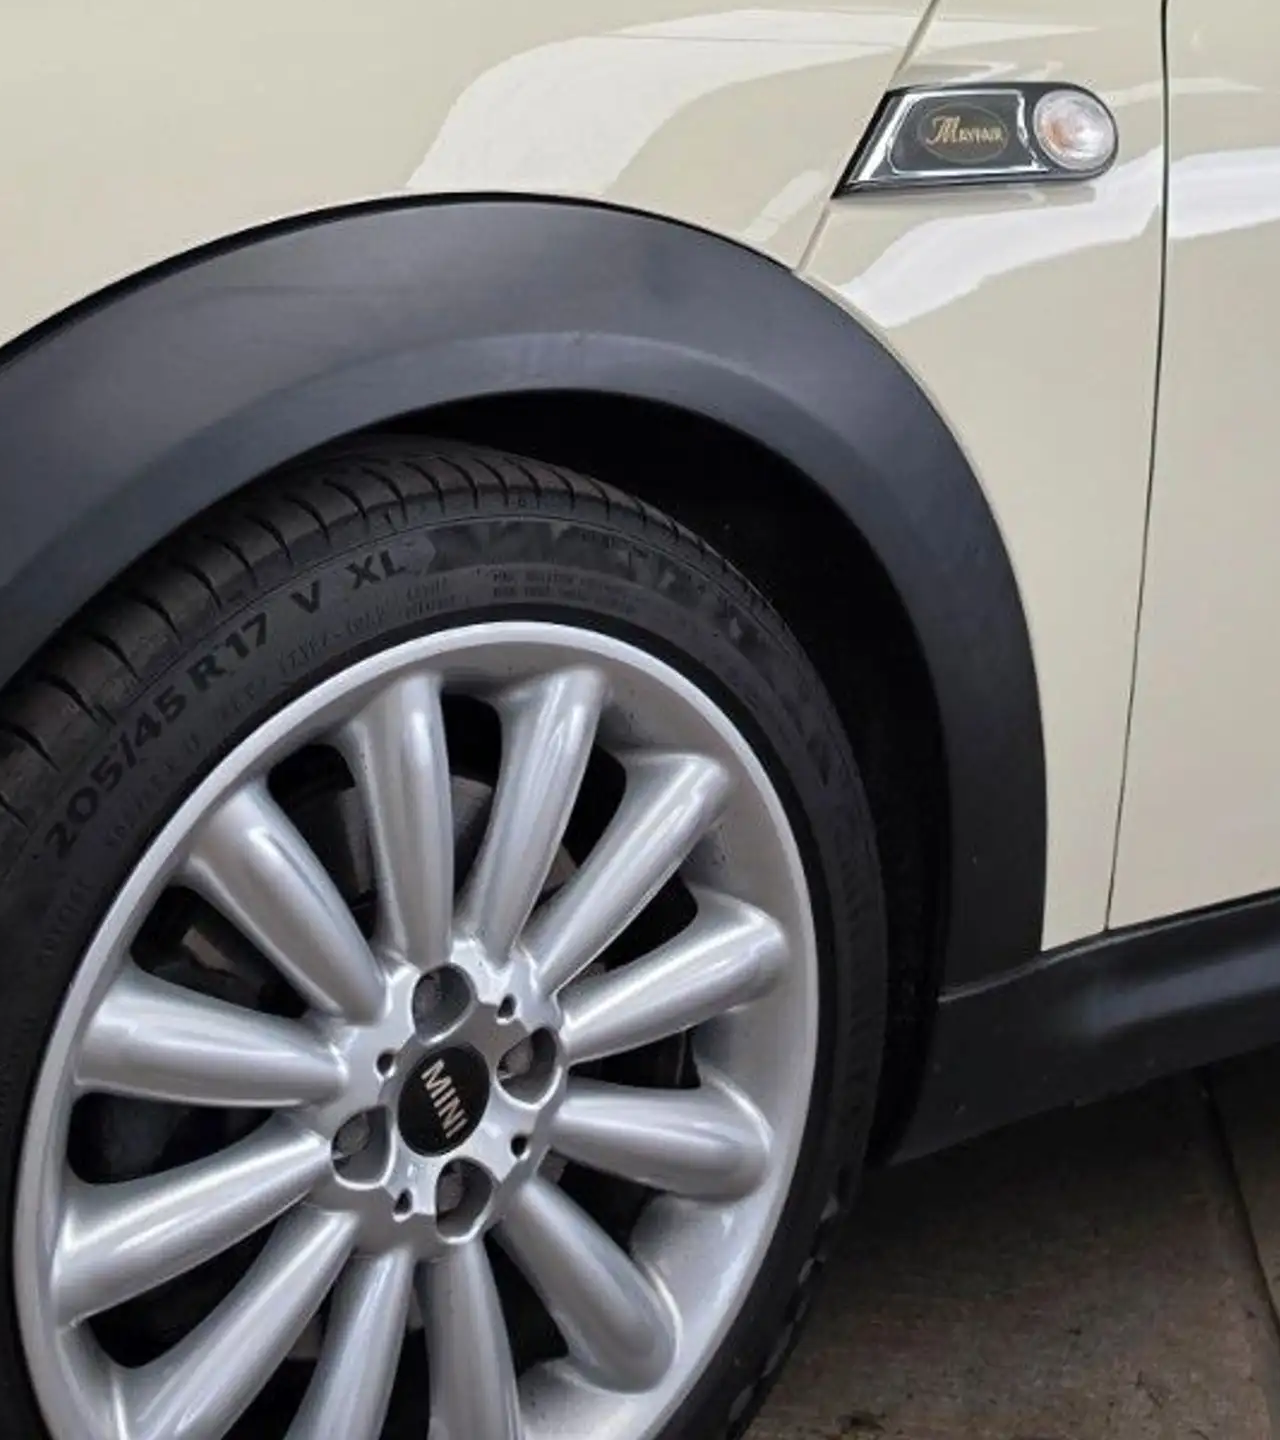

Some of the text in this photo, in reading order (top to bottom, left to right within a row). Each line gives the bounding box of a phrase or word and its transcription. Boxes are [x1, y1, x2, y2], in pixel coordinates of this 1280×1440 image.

[43, 686, 187, 860] 205/45
[186, 610, 268, 692] R17
[290, 579, 321, 614] V
[345, 548, 406, 590] XL
[421, 1058, 469, 1140] MINI
